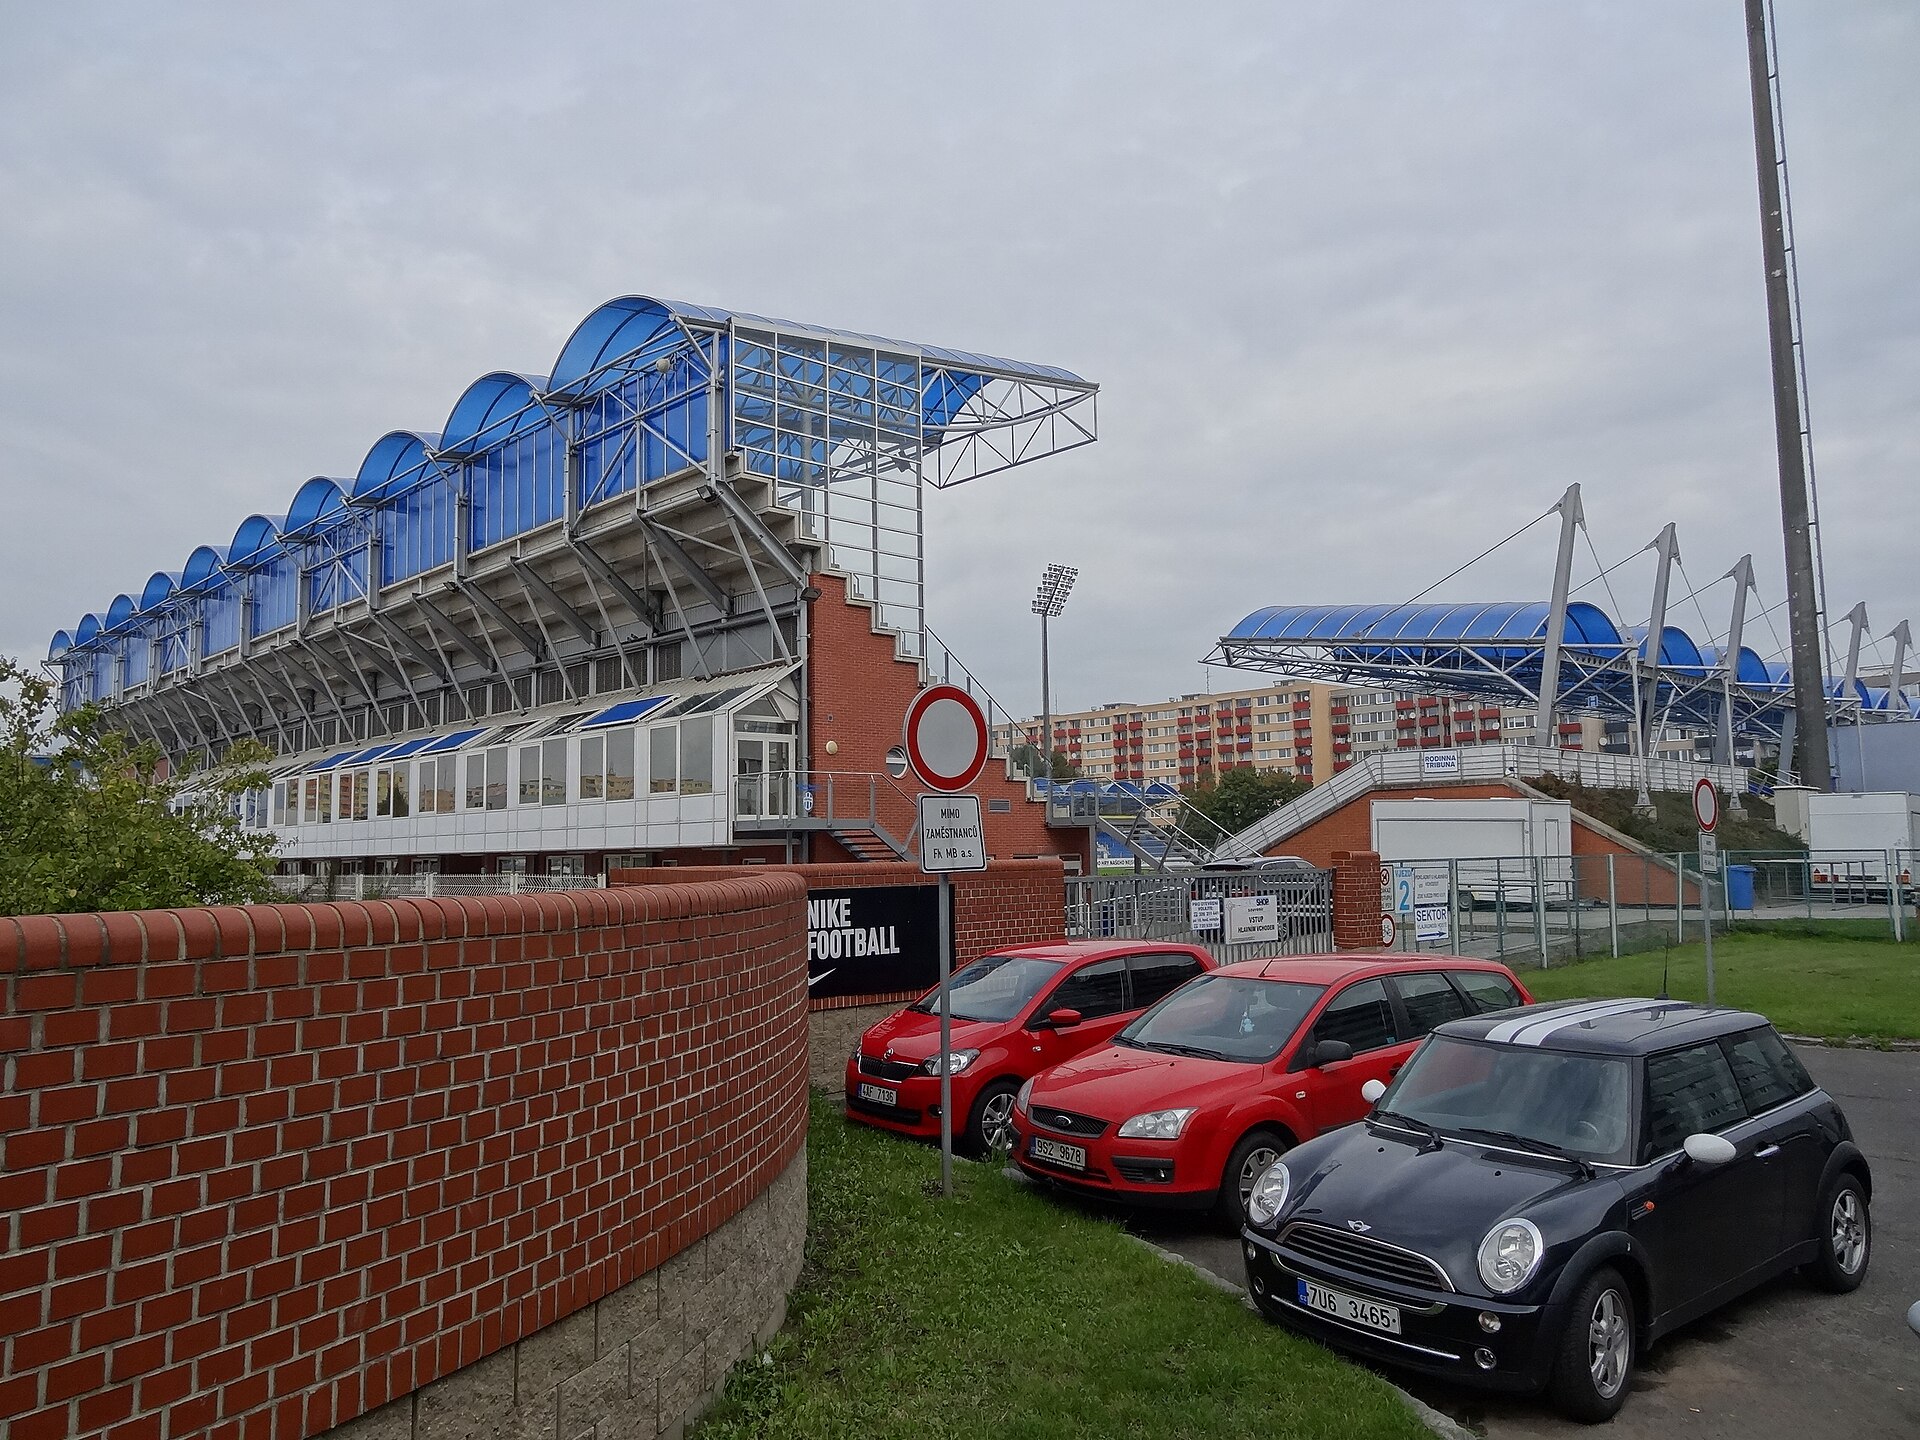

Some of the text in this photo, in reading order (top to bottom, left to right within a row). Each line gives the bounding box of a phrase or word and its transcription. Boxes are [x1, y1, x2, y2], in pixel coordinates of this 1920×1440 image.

[940, 808, 960, 819] MIMO
[925, 825, 978, 839] ZAMĚSTNANCŮ
[945, 847, 958, 858] MB
[961, 849, 974, 858] a.s.
[1256, 898, 1270, 906] SHOP
[1399, 880, 1410, 911] 2
[807, 898, 851, 929] NIKE
[1248, 915, 1264, 923] VSTUP
[1416, 908, 1447, 922] SEKTOR
[807, 926, 900, 961] FOOTBALL
[1037, 1139, 1054, 1156] 9S2
[1059, 1145, 1081, 1163] 9678
[1309, 1286, 1391, 1328] 7U6 3465
